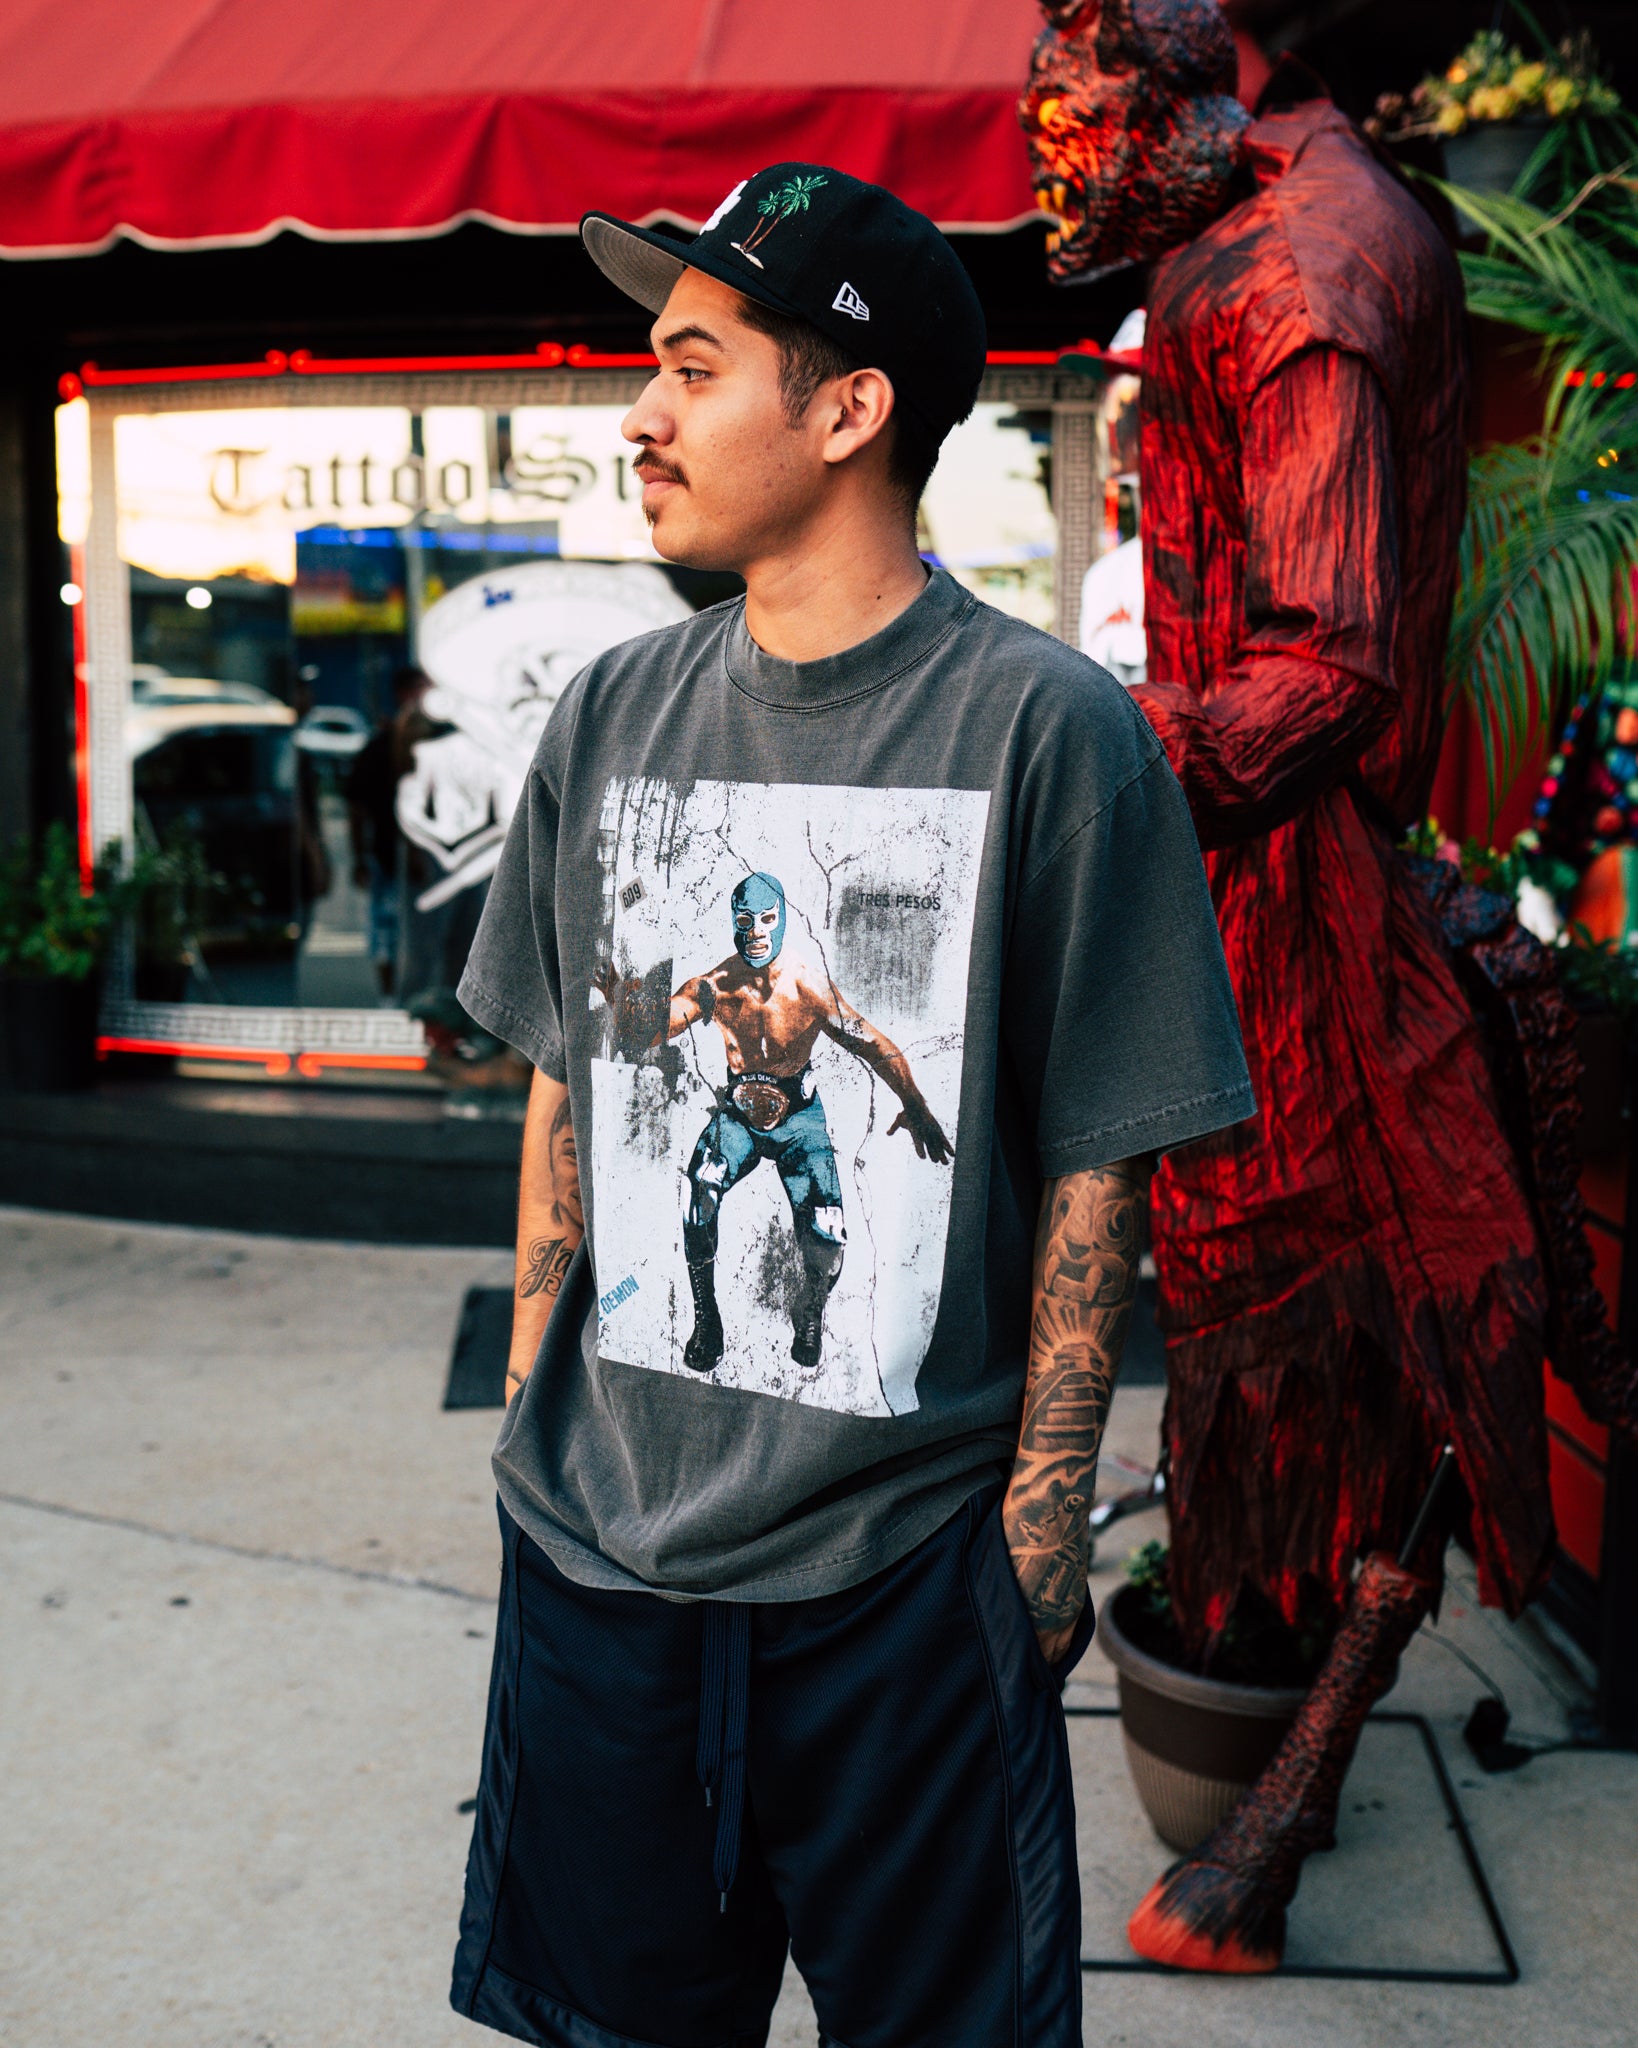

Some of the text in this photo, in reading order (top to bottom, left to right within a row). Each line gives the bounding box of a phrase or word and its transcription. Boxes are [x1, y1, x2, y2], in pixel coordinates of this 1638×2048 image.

[207, 447, 473, 514] Tattoo
[622, 883, 642, 908] 609
[858, 893, 941, 910] TRES PESOS
[600, 1274, 640, 1315] DEMON
